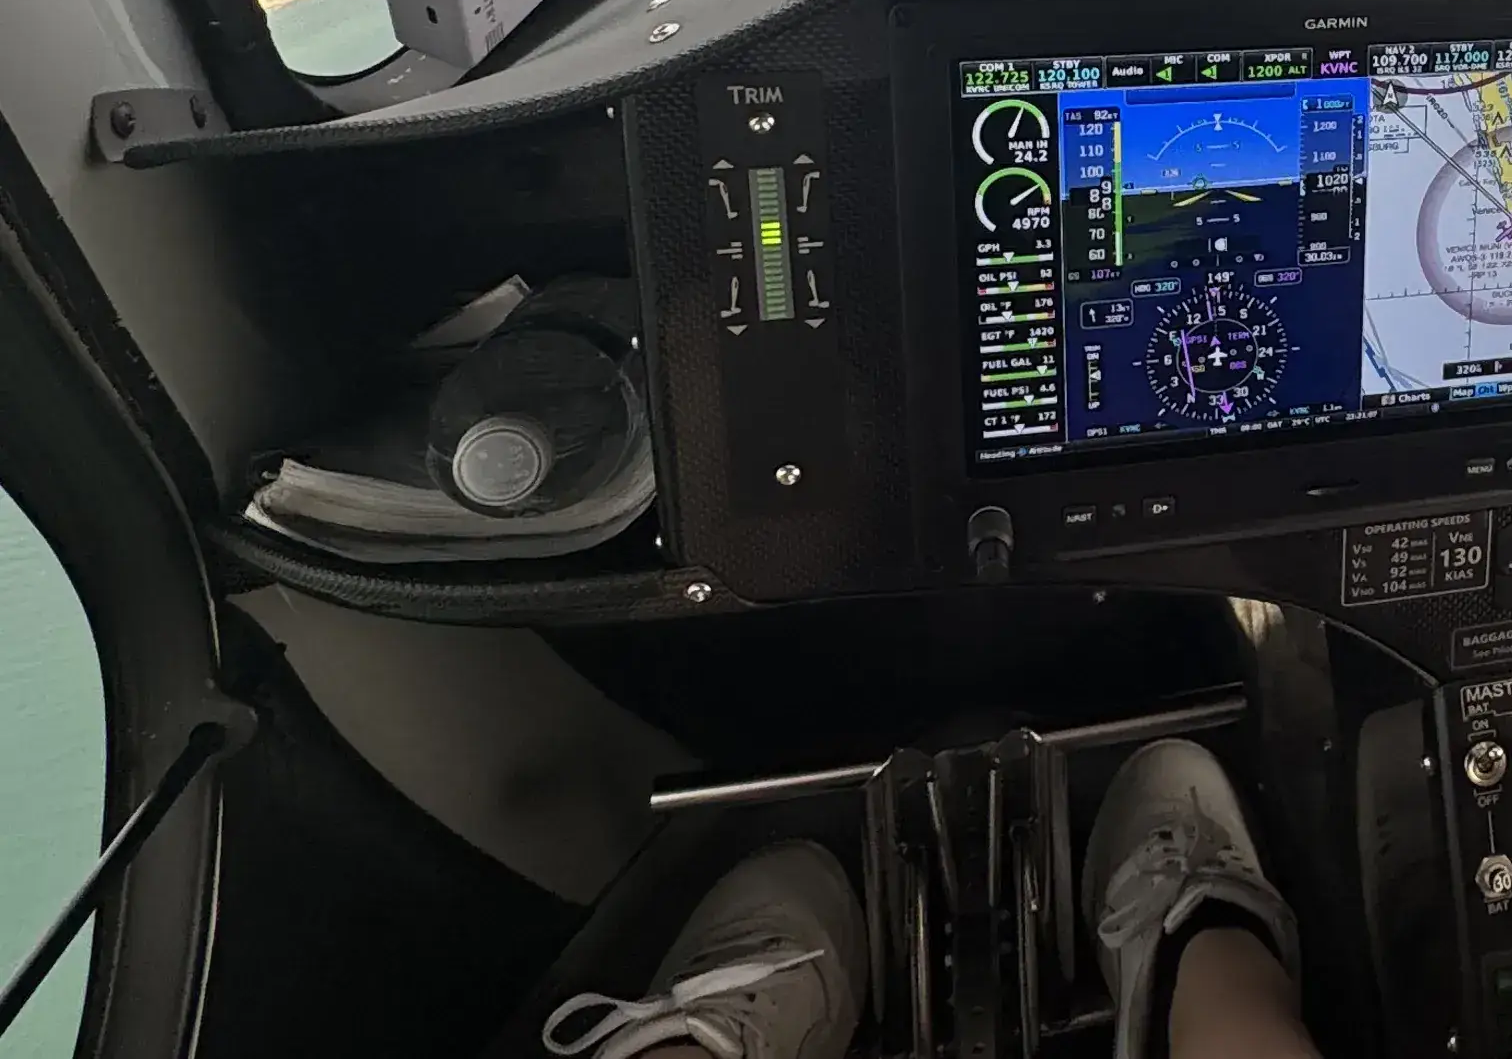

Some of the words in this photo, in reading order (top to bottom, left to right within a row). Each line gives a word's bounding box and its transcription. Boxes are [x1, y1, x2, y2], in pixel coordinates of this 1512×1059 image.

[1304, 17, 1368, 30] GARMIN
[1385, 46, 1406, 55] NAV
[1450, 43, 1474, 53] STBY
[1164, 55, 1184, 65] MIC
[1207, 53, 1230, 63] COM
[1264, 53, 1292, 62] XPDR
[1328, 50, 1351, 60] WPT
[1372, 53, 1428, 67] 109.700
[1435, 50, 1489, 64] 117.000
[979, 63, 1004, 72] COM
[1053, 60, 1081, 69] STBY
[1320, 62, 1358, 75] KVNC
[1038, 68, 1100, 82] 120.100
[1112, 66, 1143, 77] Audio
[1248, 65, 1282, 78] 1200
[1288, 66, 1307, 75] ALT
[966, 70, 1029, 85] 122.725
[1066, 80, 1098, 89] TOWER
[727, 85, 783, 105] TRIM
[1079, 124, 1103, 136] 120
[1313, 121, 1337, 132] 1200
[1008, 141, 1033, 151] MAN
[1079, 145, 1104, 157] 110
[1014, 150, 1048, 163] 24.2
[1080, 166, 1104, 178] 100
[1027, 207, 1050, 216] RPM
[1012, 217, 1050, 229] 4970
[1088, 228, 1105, 239] 70
[977, 243, 1000, 253] GPH
[1088, 249, 1105, 260] 60
[979, 273, 997, 282] OIL
[999, 272, 1017, 281] PSI
[1186, 314, 1201, 325] 12
[981, 331, 1001, 341] EGT
[1253, 325, 1266, 336] 21
[1258, 347, 1273, 358] 24
[982, 360, 1008, 369] FUEL
[1010, 357, 1032, 367] GAL
[983, 388, 1009, 398] FUEL
[1011, 386, 1029, 395] PSI
[1233, 387, 1249, 398] 30
[1398, 392, 1431, 403] Charts
[1453, 388, 1474, 398] Map
[984, 417, 997, 426] CT
[980, 450, 1016, 460] Heading
[1067, 512, 1092, 523] NRST
[1365, 519, 1428, 536] OPERATING
[1431, 514, 1470, 528] SPEEDS
[1391, 537, 1409, 549] 42
[1391, 551, 1408, 563] 49
[1440, 546, 1482, 567] 130
[1352, 573, 1367, 583] VA
[1390, 566, 1407, 578] 92
[1445, 568, 1474, 581] KIAS
[1382, 580, 1407, 593] 104
[1468, 702, 1490, 713] BAT
[1472, 719, 1488, 731] ON
[1477, 795, 1500, 807] OFF
[1493, 874, 1511, 893] 30
[1487, 899, 1509, 915] BAT
